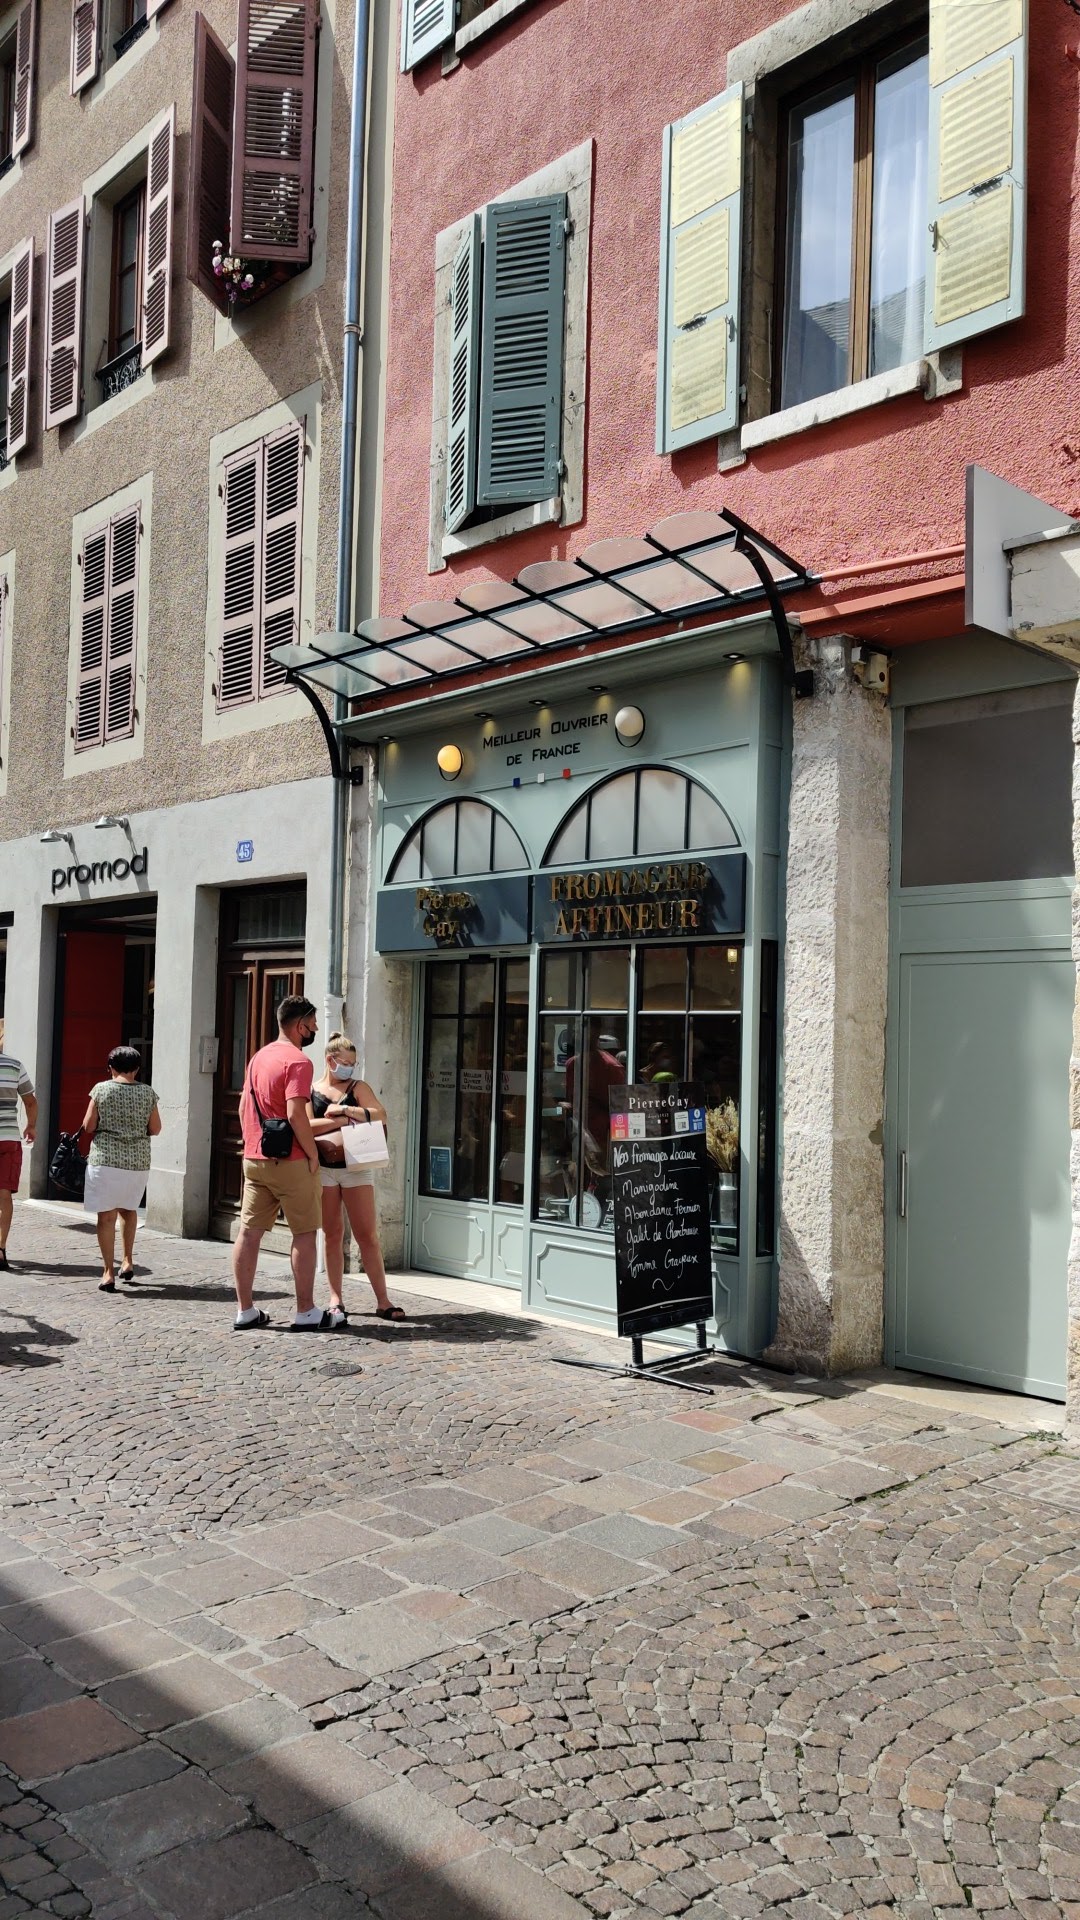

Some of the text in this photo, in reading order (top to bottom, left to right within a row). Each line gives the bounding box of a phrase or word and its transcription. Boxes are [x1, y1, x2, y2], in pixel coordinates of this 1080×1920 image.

[483, 713, 609, 749] MEILLEUR OUVRIER
[506, 742, 581, 766] DE FRANCE
[238, 843, 250, 859] 45
[51, 846, 148, 896] promod
[549, 862, 708, 902] FROMAGER
[553, 899, 700, 936] AFFINEUR
[613, 1144, 629, 1168] Nos
[632, 1142, 669, 1178] fromages
[622, 1174, 679, 1205] Manigodine
[653, 1221, 663, 1242] de
